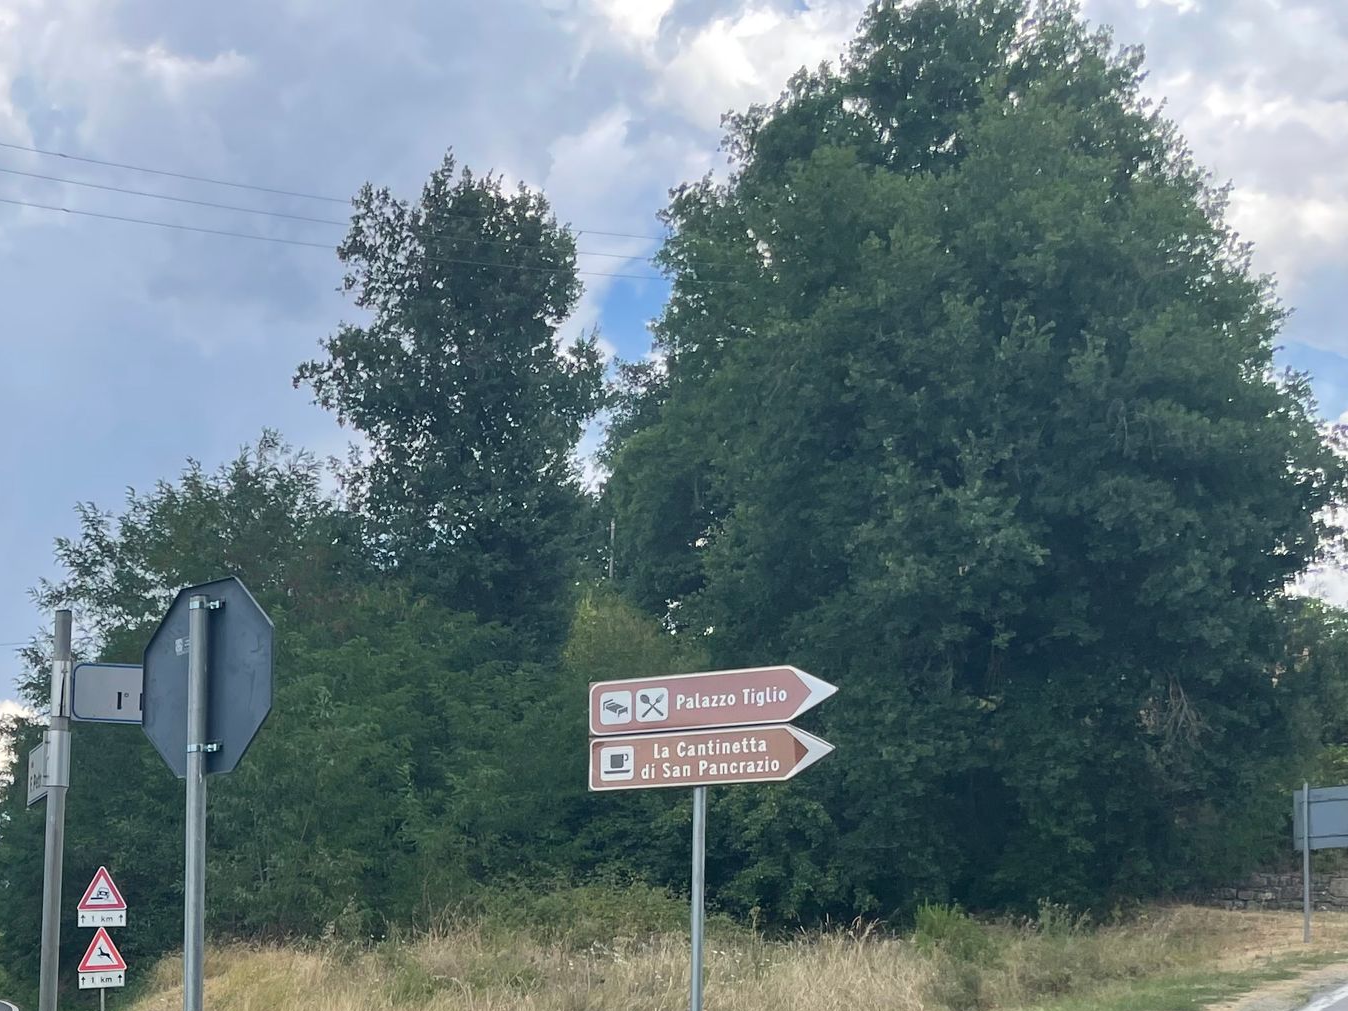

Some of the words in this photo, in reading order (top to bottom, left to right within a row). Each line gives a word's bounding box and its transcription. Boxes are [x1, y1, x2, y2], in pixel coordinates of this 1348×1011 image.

[676, 693, 736, 710] Palazzo
[742, 686, 787, 706] Tiglio
[653, 743, 670, 759] La
[676, 736, 767, 758] Cantinetta
[641, 763, 656, 779] di
[662, 762, 692, 778] San
[698, 756, 780, 776] Pancrazio
[101, 915, 113, 923] km
